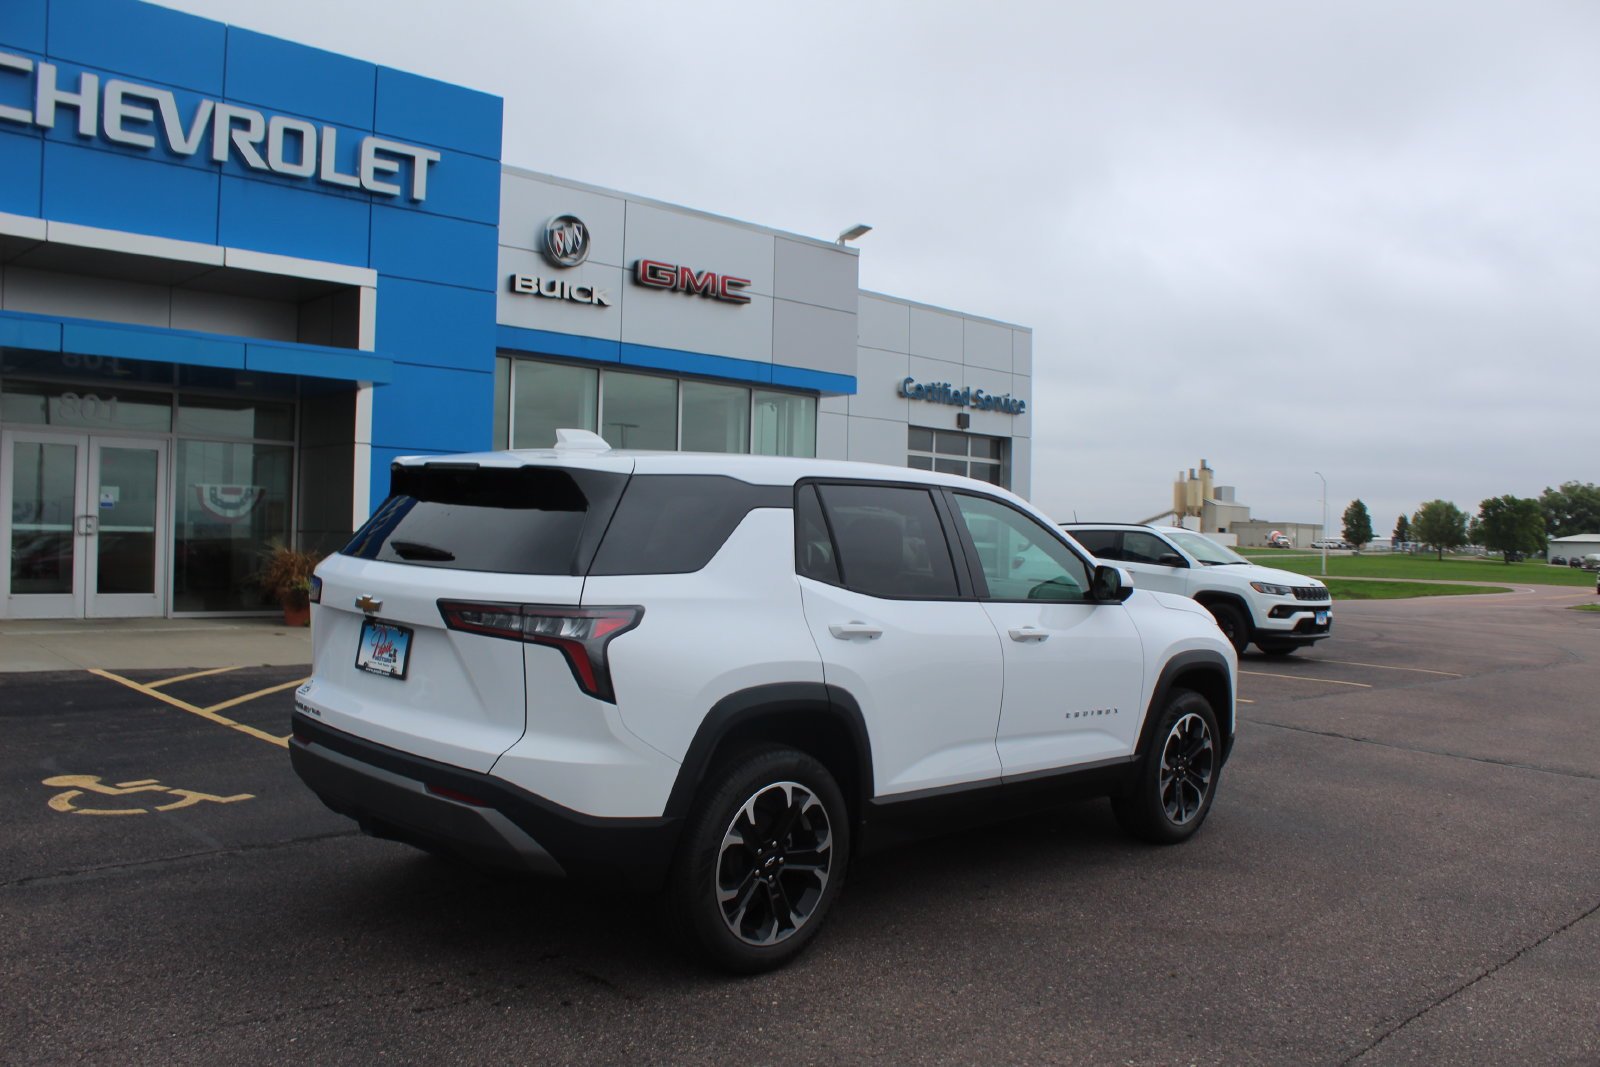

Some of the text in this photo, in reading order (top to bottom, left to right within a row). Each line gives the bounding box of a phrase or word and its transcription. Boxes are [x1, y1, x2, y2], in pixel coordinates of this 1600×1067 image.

[513, 273, 612, 306] BUICK
[635, 258, 752, 304] GMC
[58, 392, 118, 421] 801
[901, 376, 1026, 415] Certified Service
